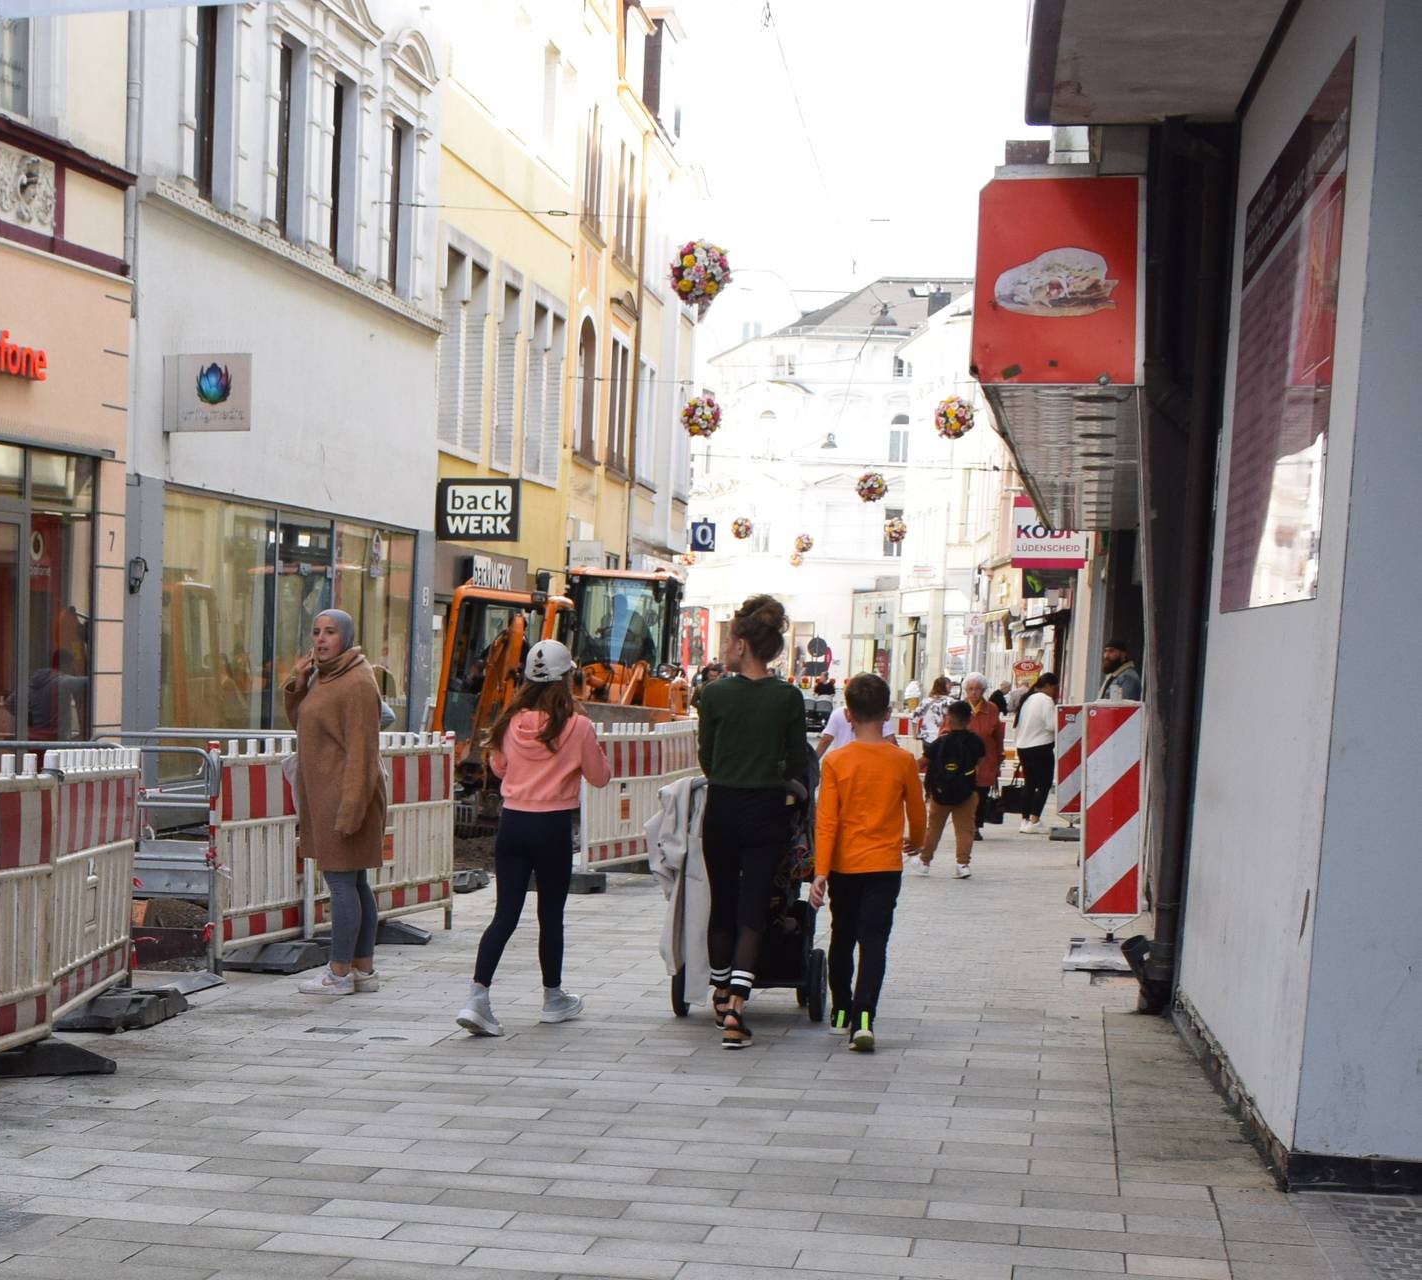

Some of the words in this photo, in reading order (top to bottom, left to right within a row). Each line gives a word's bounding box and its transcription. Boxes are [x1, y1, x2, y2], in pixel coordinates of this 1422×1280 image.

[451, 489, 507, 511] back
[446, 515, 511, 535] WERK
[109, 531, 116, 552] 7
[1016, 542, 1081, 553] LÜDENSCHEID
